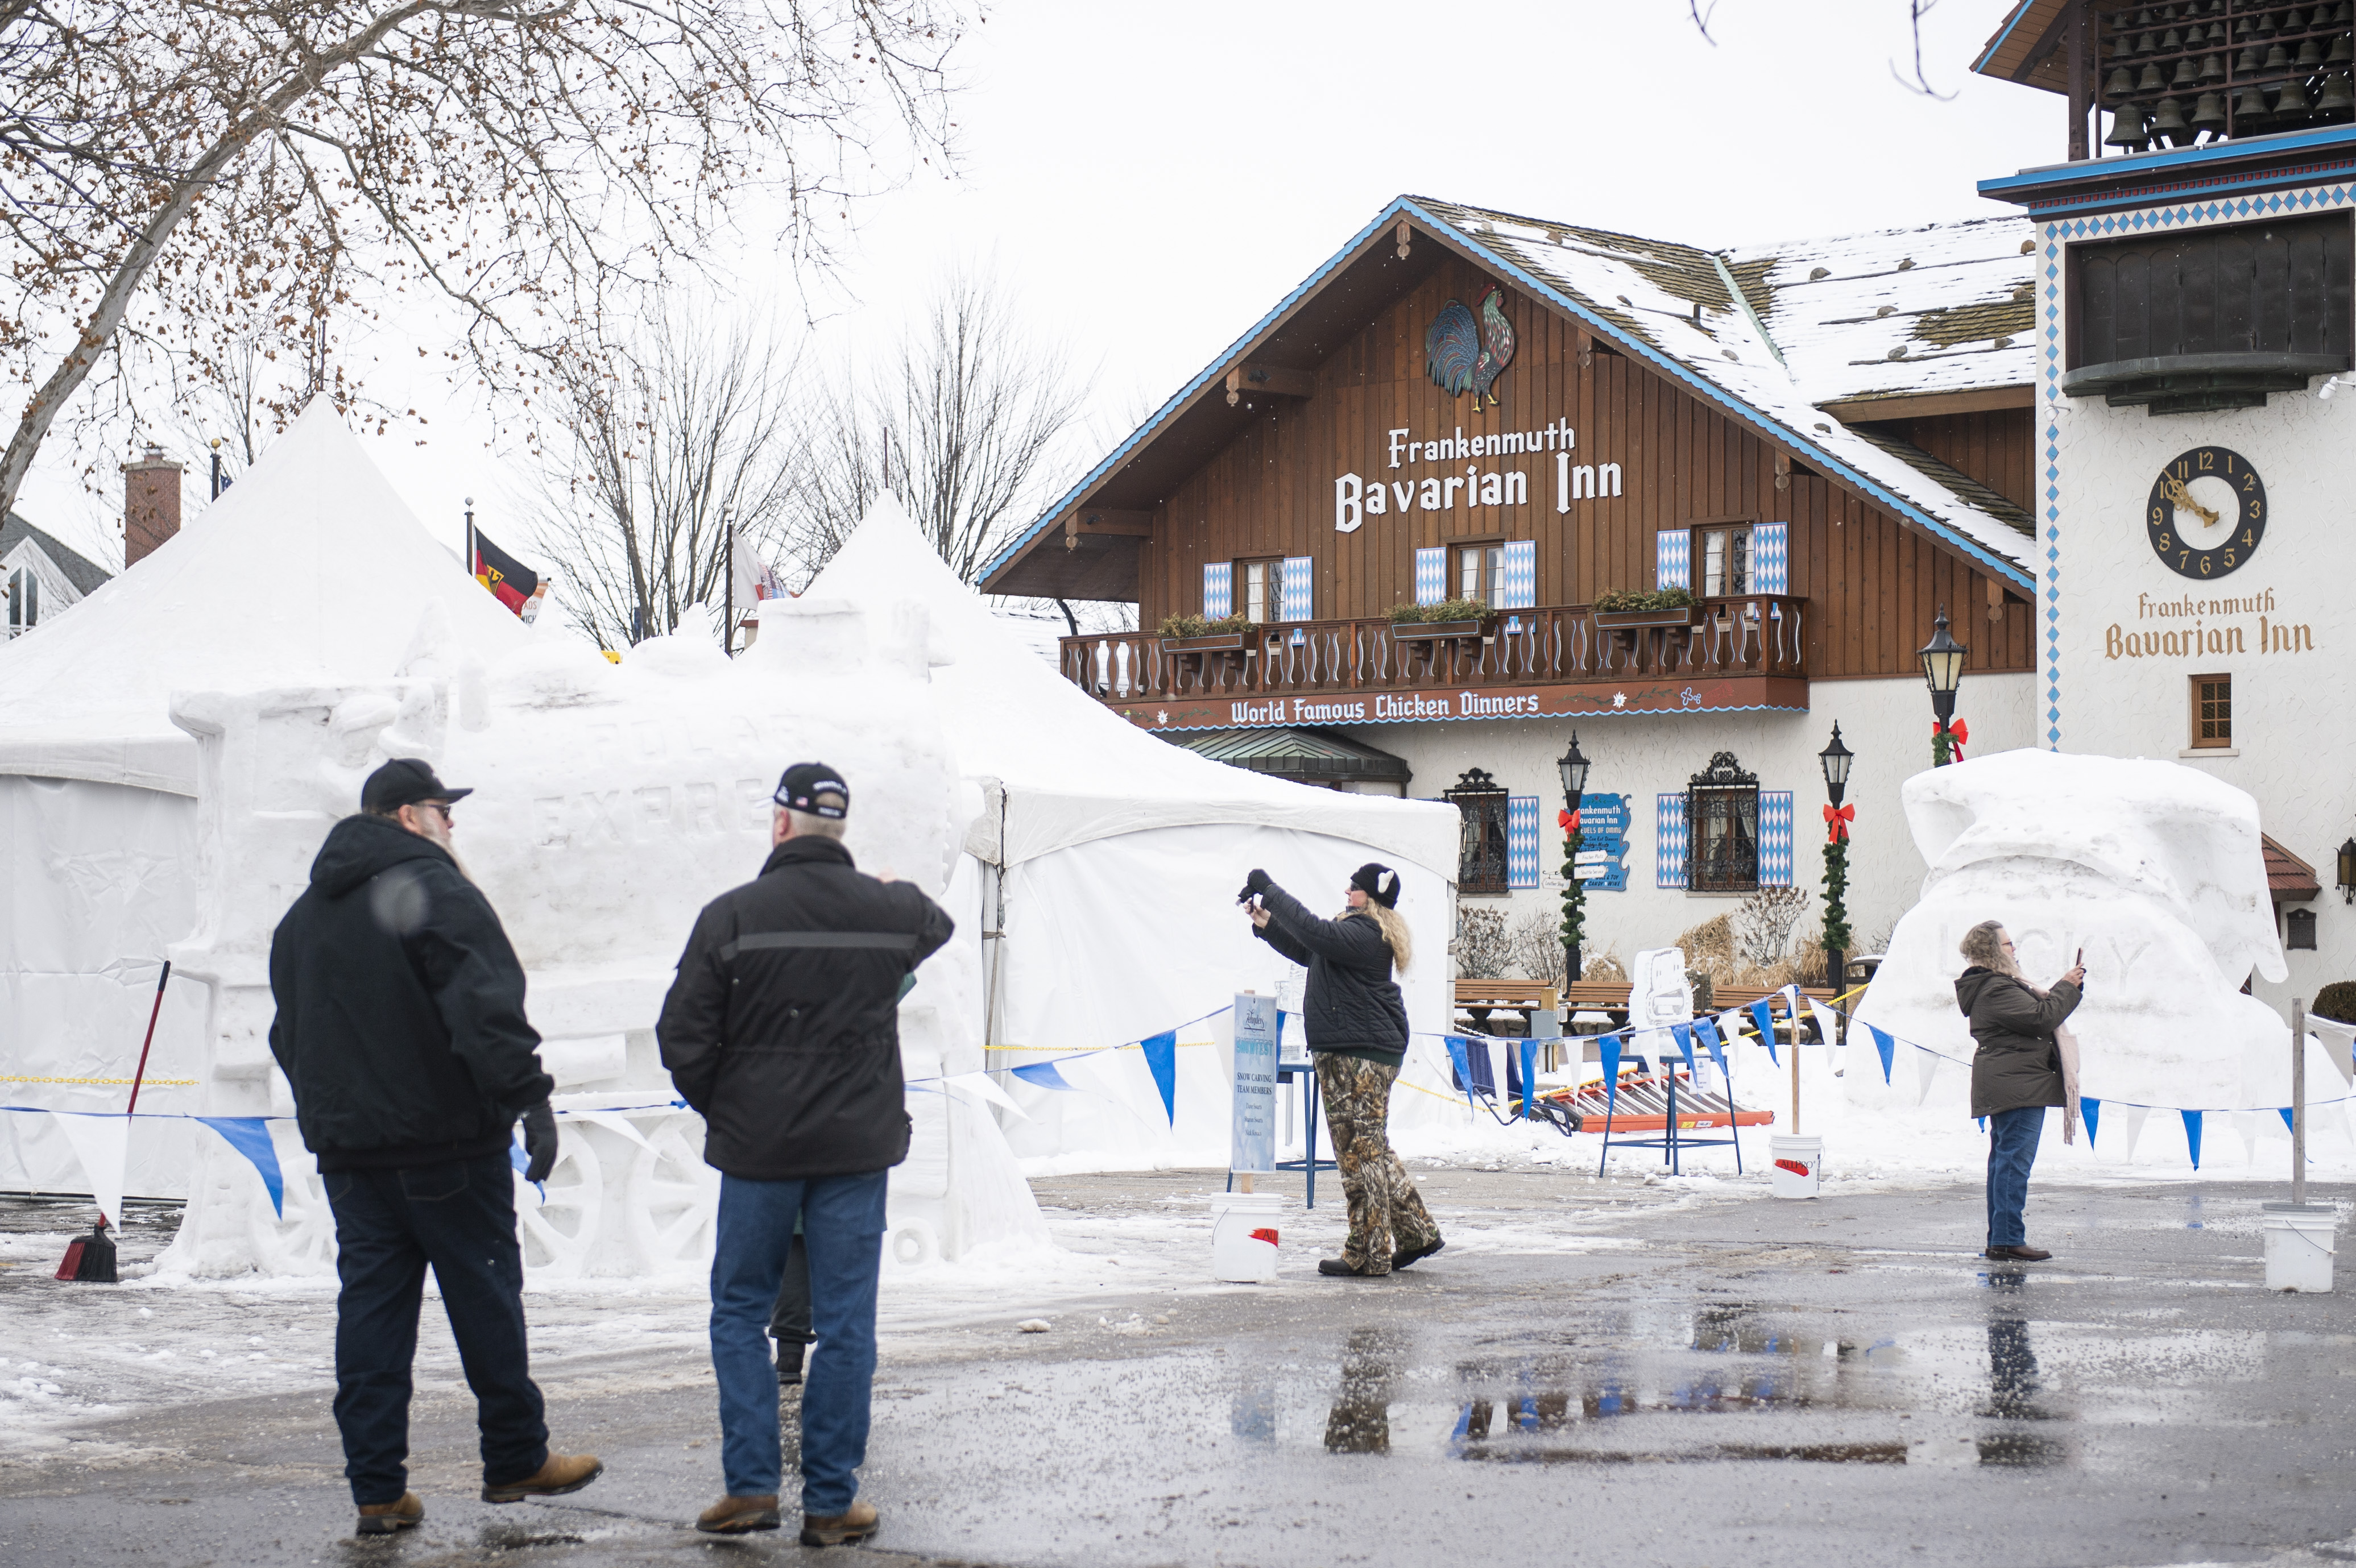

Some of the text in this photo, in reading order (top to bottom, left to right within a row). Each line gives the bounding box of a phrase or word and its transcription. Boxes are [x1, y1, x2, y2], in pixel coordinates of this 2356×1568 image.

[1388, 417, 1575, 468] Frankenmuth
[2177, 461, 2189, 479] 11
[2198, 451, 2214, 471] 12
[2227, 455, 2234, 474] 1
[2243, 472, 2256, 491] 2
[1335, 451, 1622, 533] Bavarian Inn
[2152, 506, 2163, 526] 9
[2249, 499, 2262, 519] 3
[2159, 533, 2171, 551] 8
[2242, 528, 2254, 547] 4
[2178, 550, 2190, 570] 7
[2200, 555, 2211, 575] 6
[2223, 548, 2235, 567] 5
[524, 600, 537, 609] ADS
[2137, 587, 2275, 620] Frankenmuth
[2105, 615, 2316, 661] Bavarian Inn
[1231, 690, 1539, 723] World Famous Chicken Dinners
[1714, 770, 1733, 782] 1888
[532, 778, 770, 847] EXPRE
[1579, 804, 1621, 814] ankenmuth
[1580, 814, 1618, 824] avarian Inn
[1937, 923, 2152, 996] LCKY
[1237, 1072, 1272, 1082] SNOW CARVING
[1237, 1085, 1272, 1095] TEAM MEMBERS
